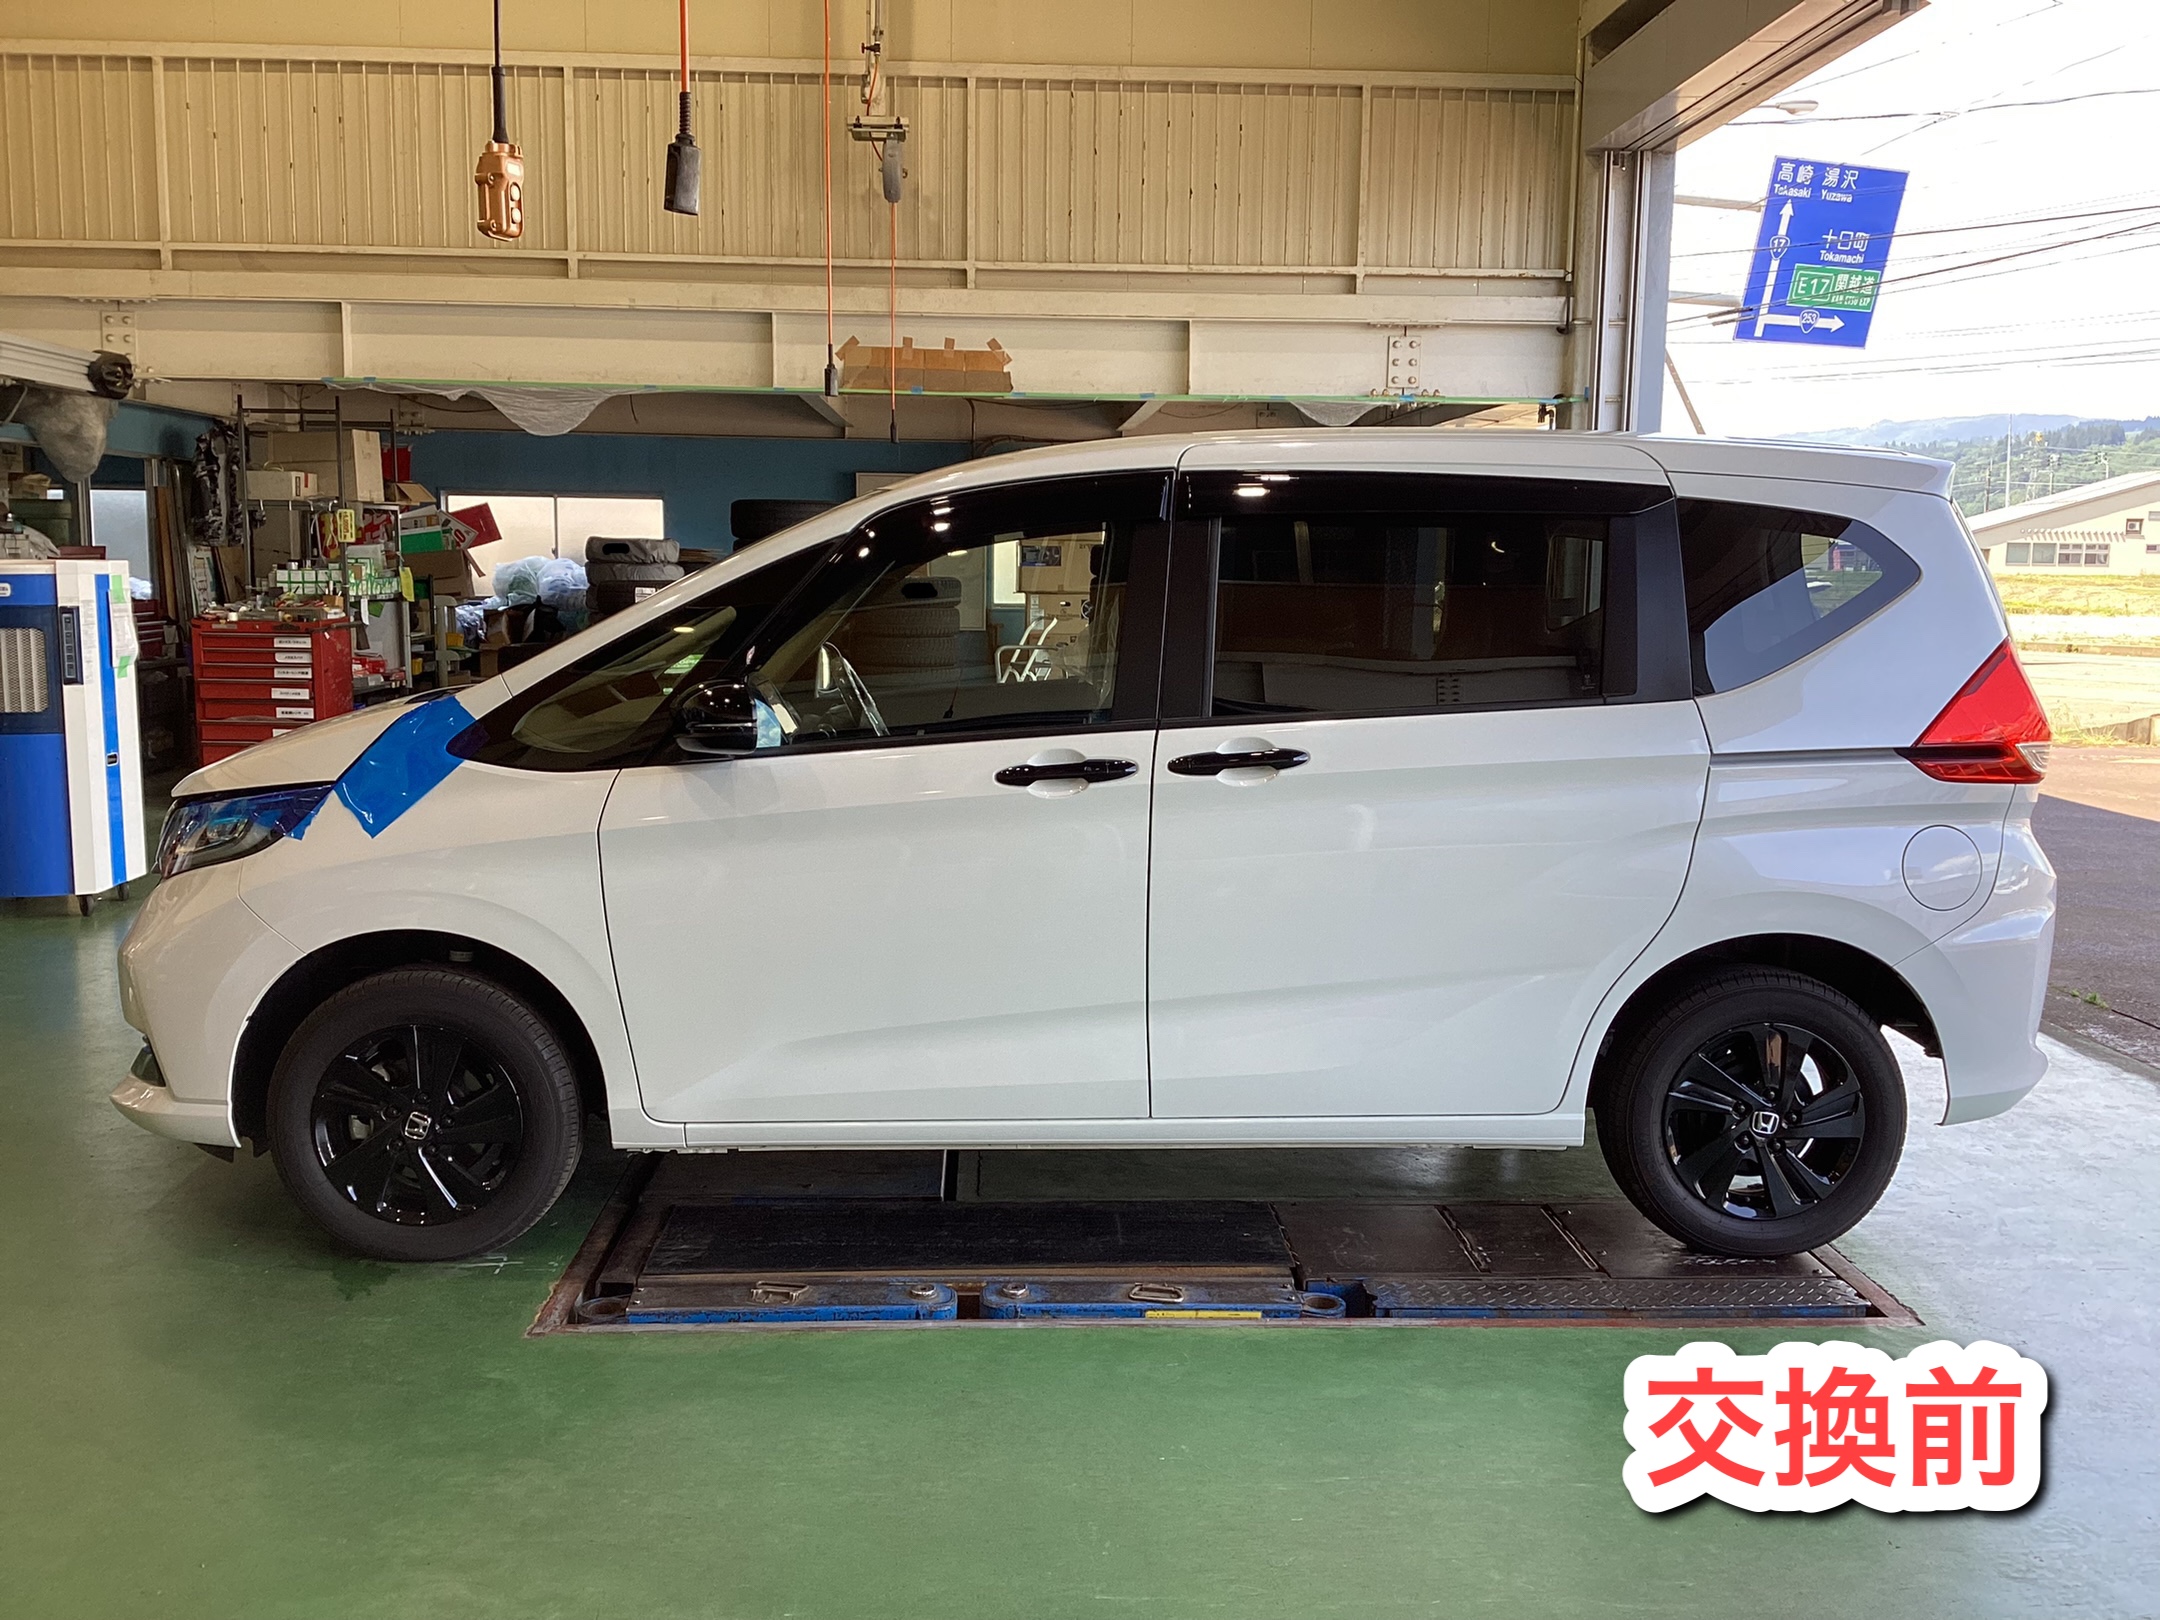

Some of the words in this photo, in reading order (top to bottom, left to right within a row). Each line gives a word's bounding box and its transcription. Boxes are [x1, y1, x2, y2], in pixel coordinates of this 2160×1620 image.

[1777, 162, 1814, 185] 高崎
[1821, 166, 1858, 189] 湯沢
[1774, 183, 1812, 198] Takasaki
[1821, 189, 1853, 203] Yuzawa
[1773, 238, 1787, 253] 17
[1819, 250, 1865, 264] Tokamachi
[1797, 276, 1831, 296] E17
